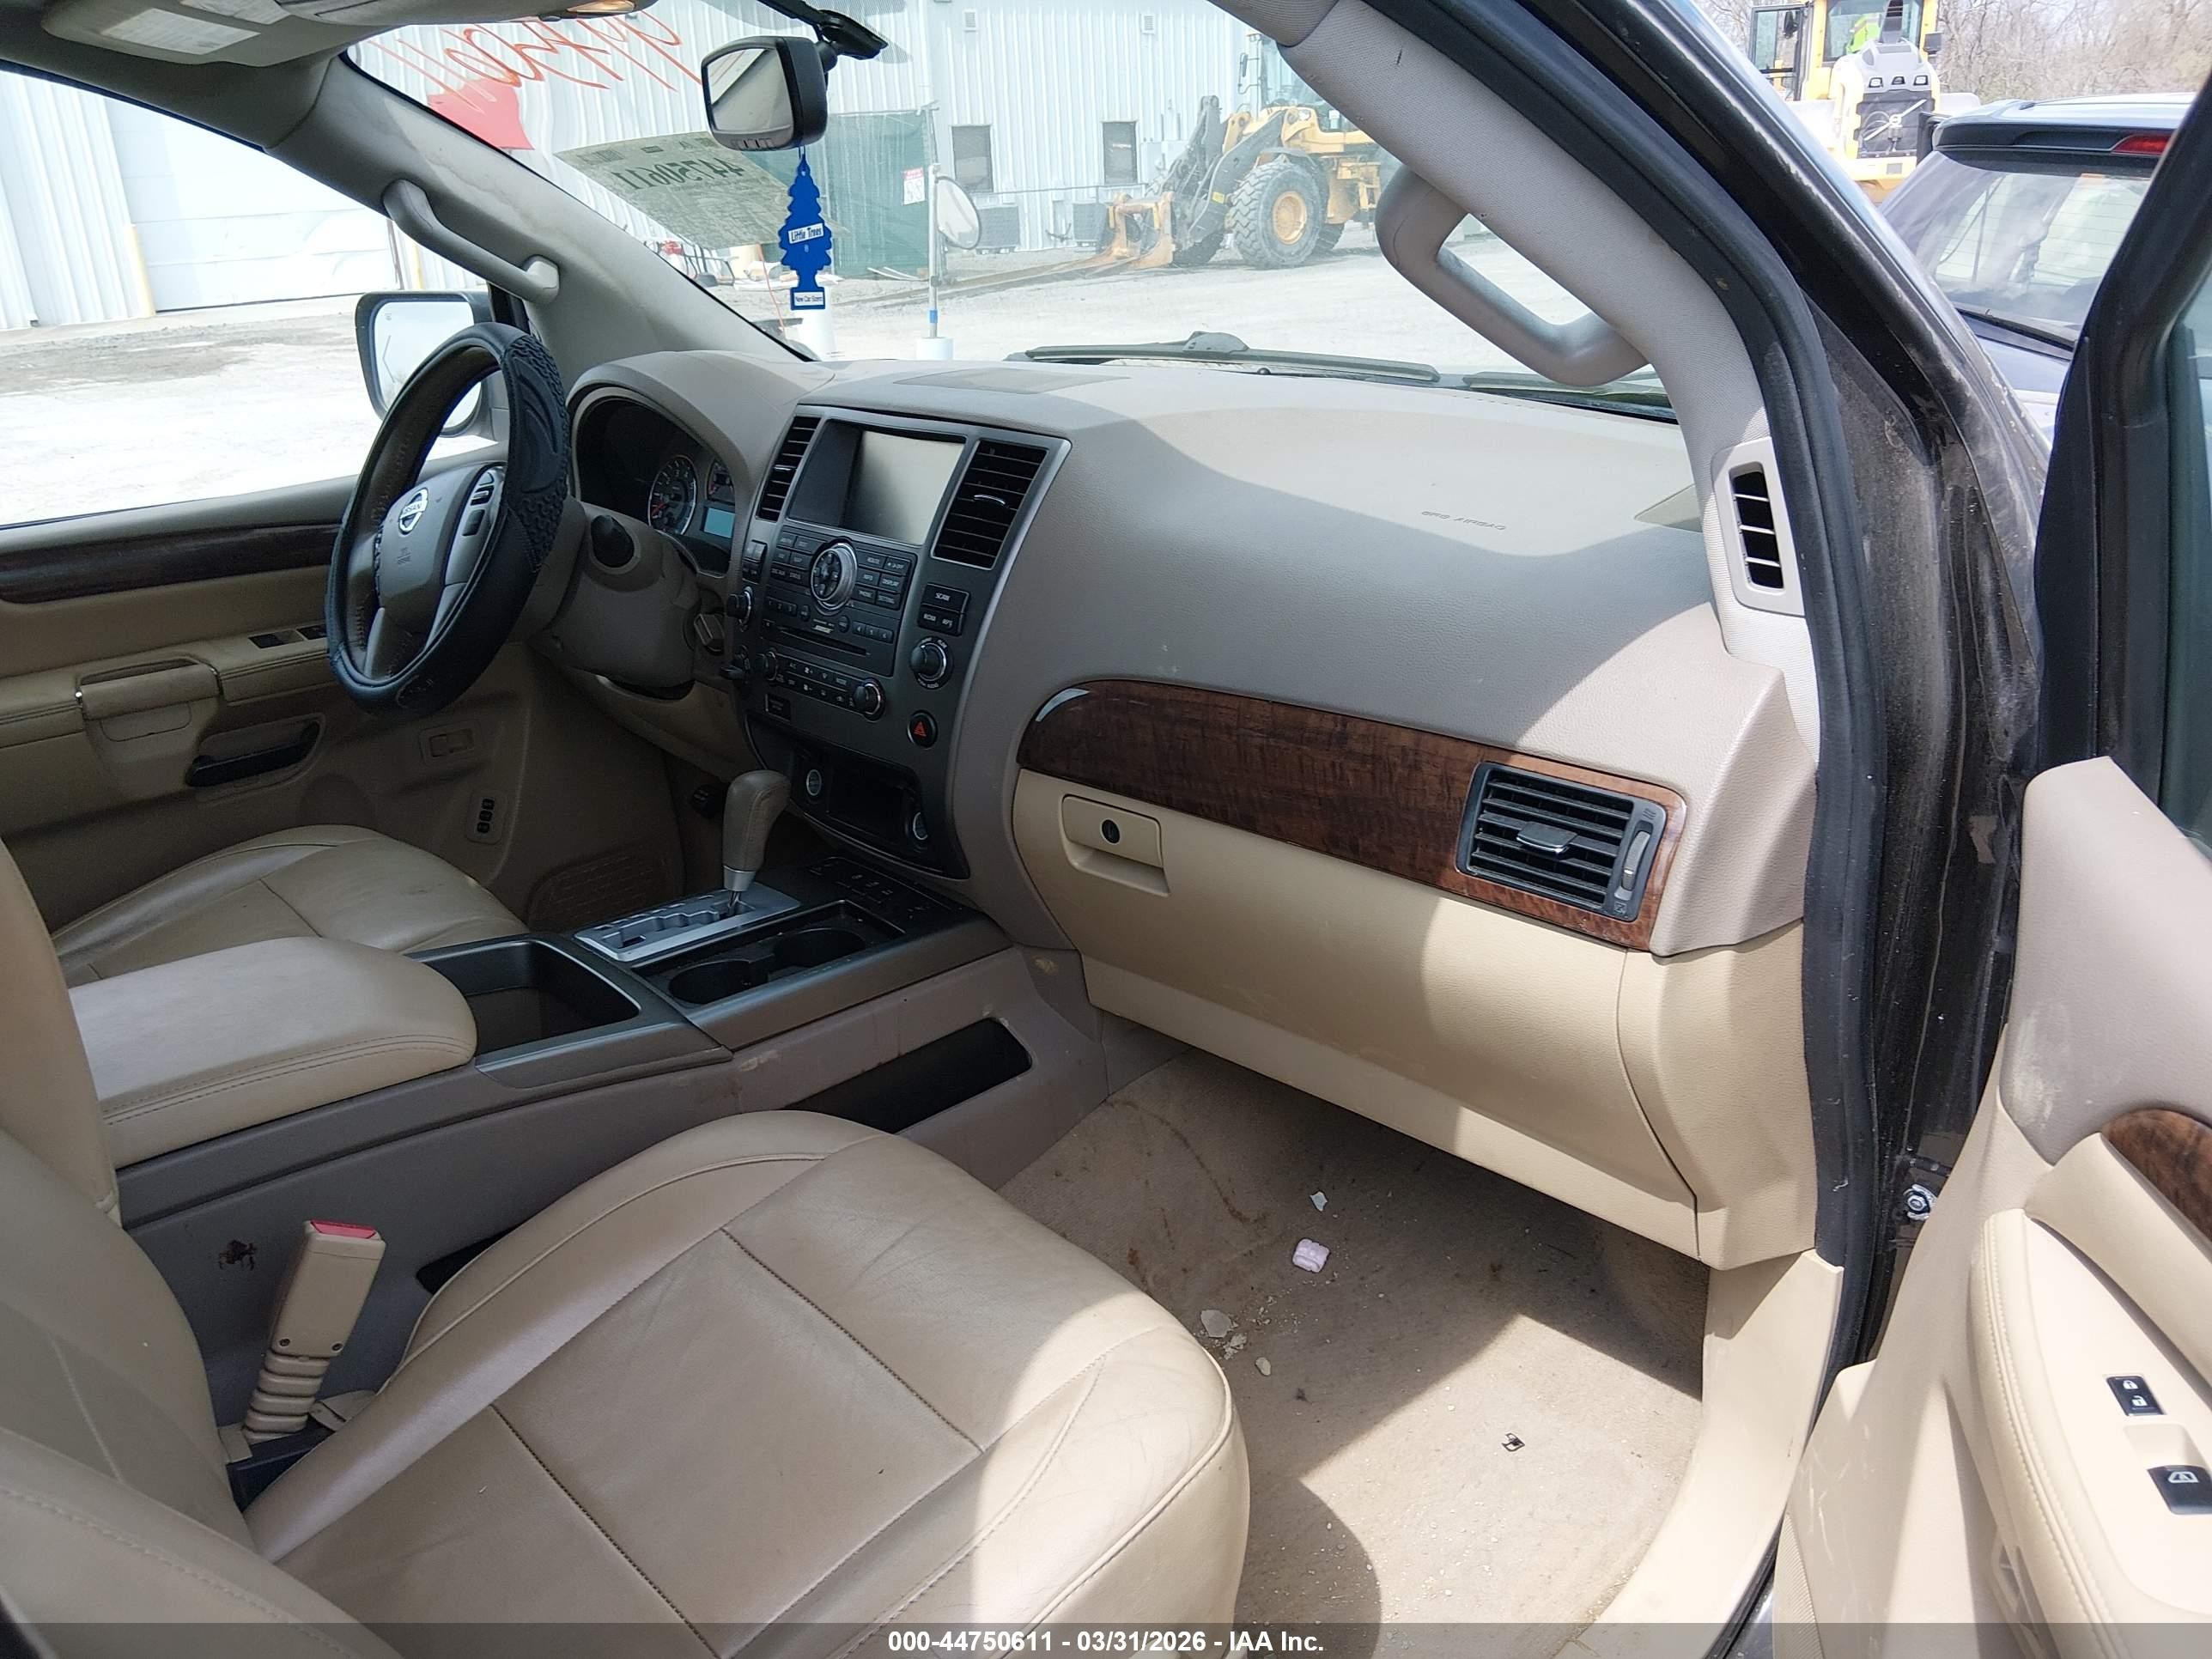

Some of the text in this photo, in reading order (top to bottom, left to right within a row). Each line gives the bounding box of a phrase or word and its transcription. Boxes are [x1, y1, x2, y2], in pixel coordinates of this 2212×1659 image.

[791, 227, 822, 242] Little Trees
[1421, 511, 1507, 531] SRS AIRBAG
